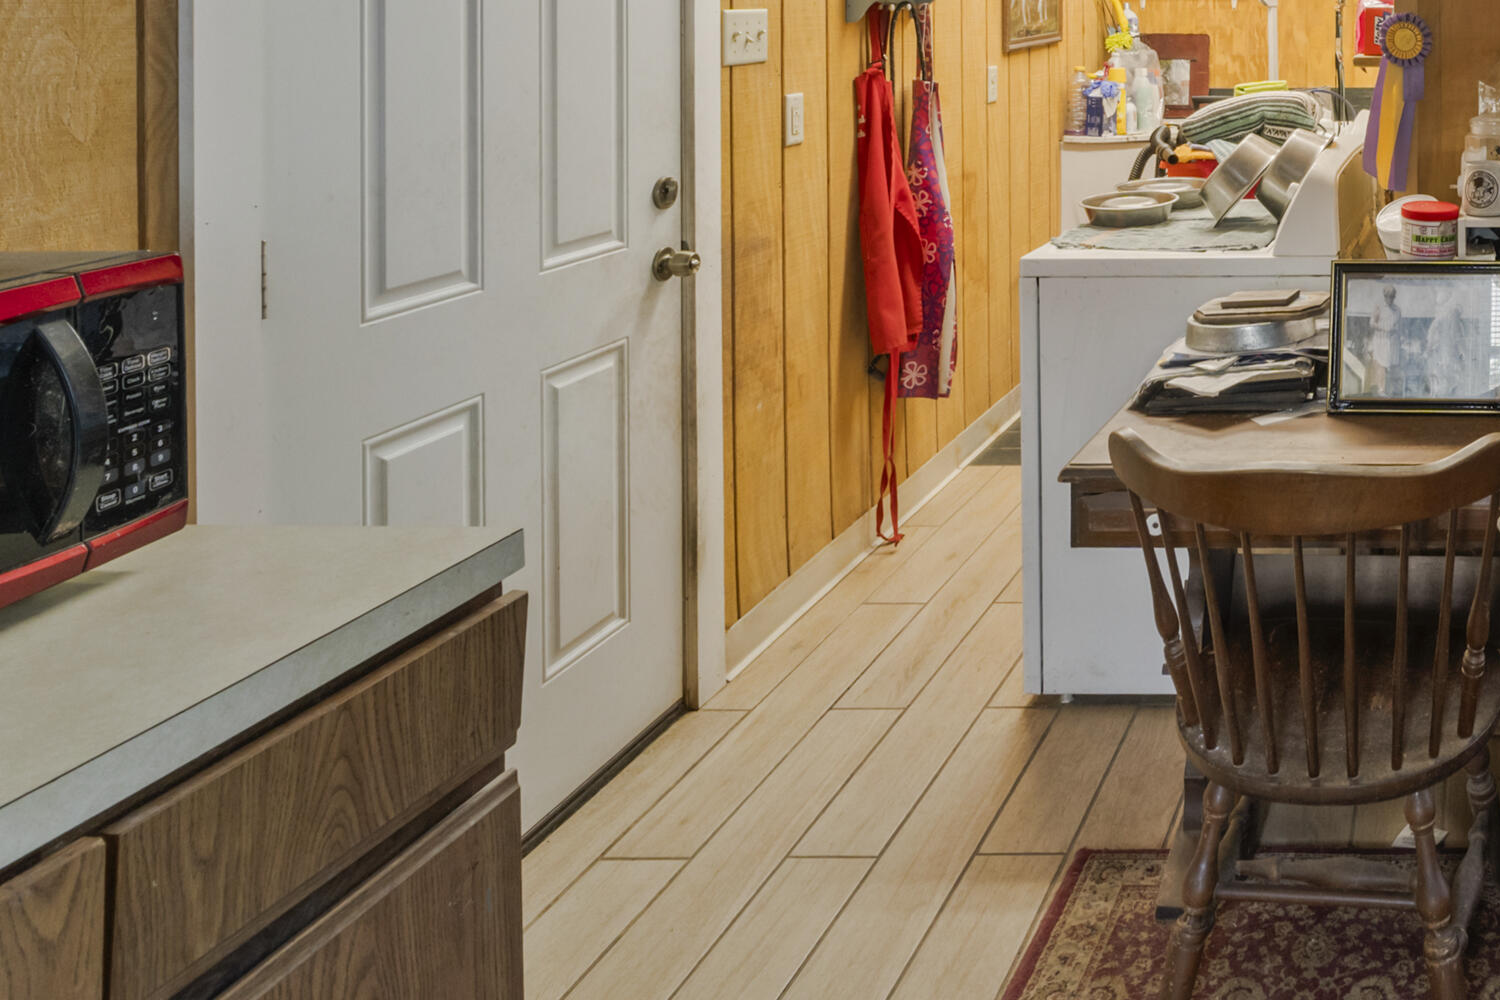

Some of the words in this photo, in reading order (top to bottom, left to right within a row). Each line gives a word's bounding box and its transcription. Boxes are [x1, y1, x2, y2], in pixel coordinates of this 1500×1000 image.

[1415, 235, 1439, 243] HAPPY
[157, 424, 163, 433] 3
[131, 433, 138, 442] 2
[131, 447, 138, 456] 5
[157, 453, 164, 462] 9
[105, 472, 111, 481] 7
